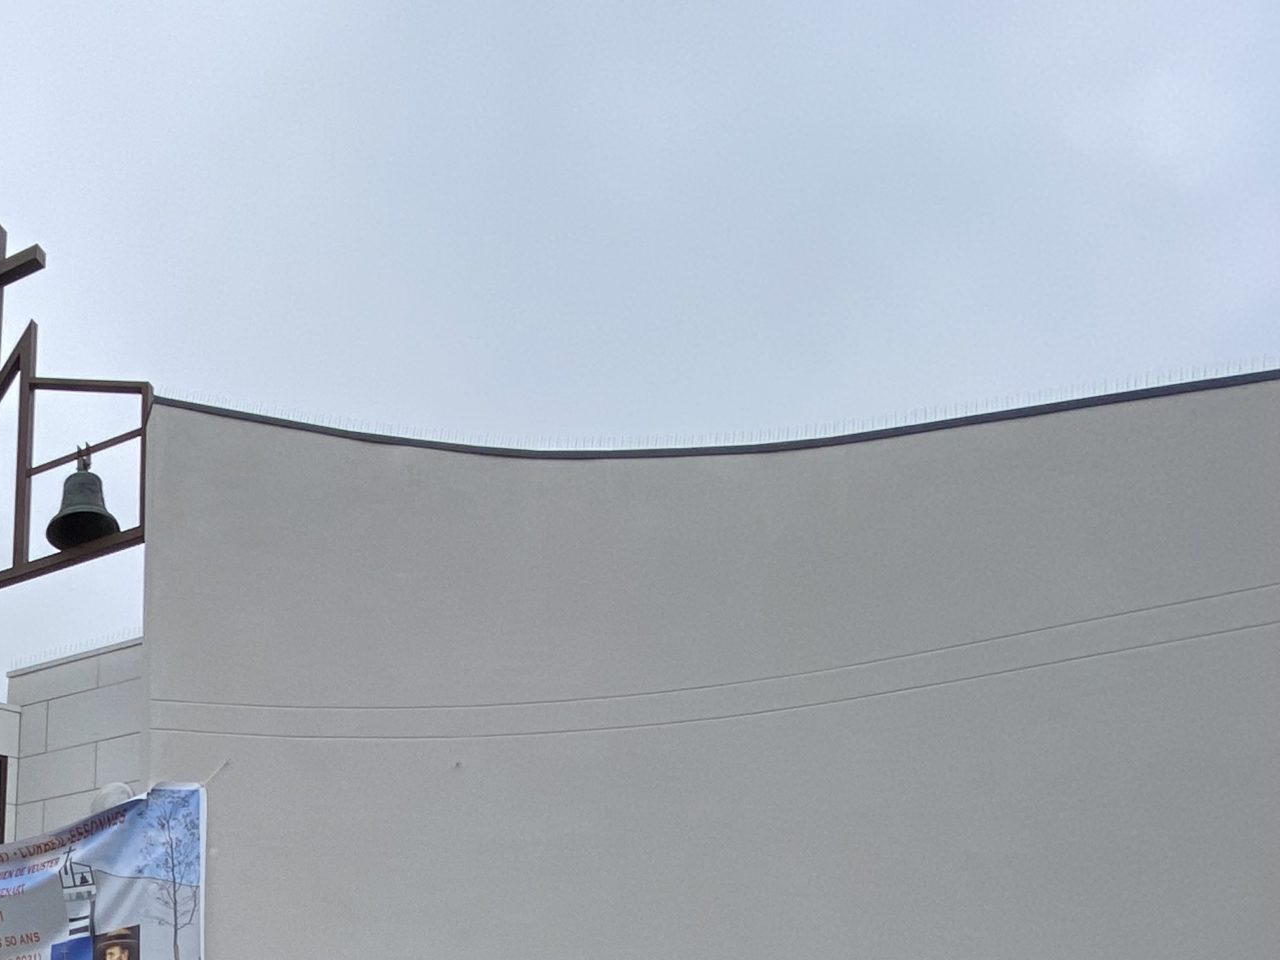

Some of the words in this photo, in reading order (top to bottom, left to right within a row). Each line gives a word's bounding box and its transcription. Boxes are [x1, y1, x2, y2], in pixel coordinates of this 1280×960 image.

[14, 866, 26, 877] DE
[4, 935, 17, 948] 50
[19, 931, 41, 945] ANS
